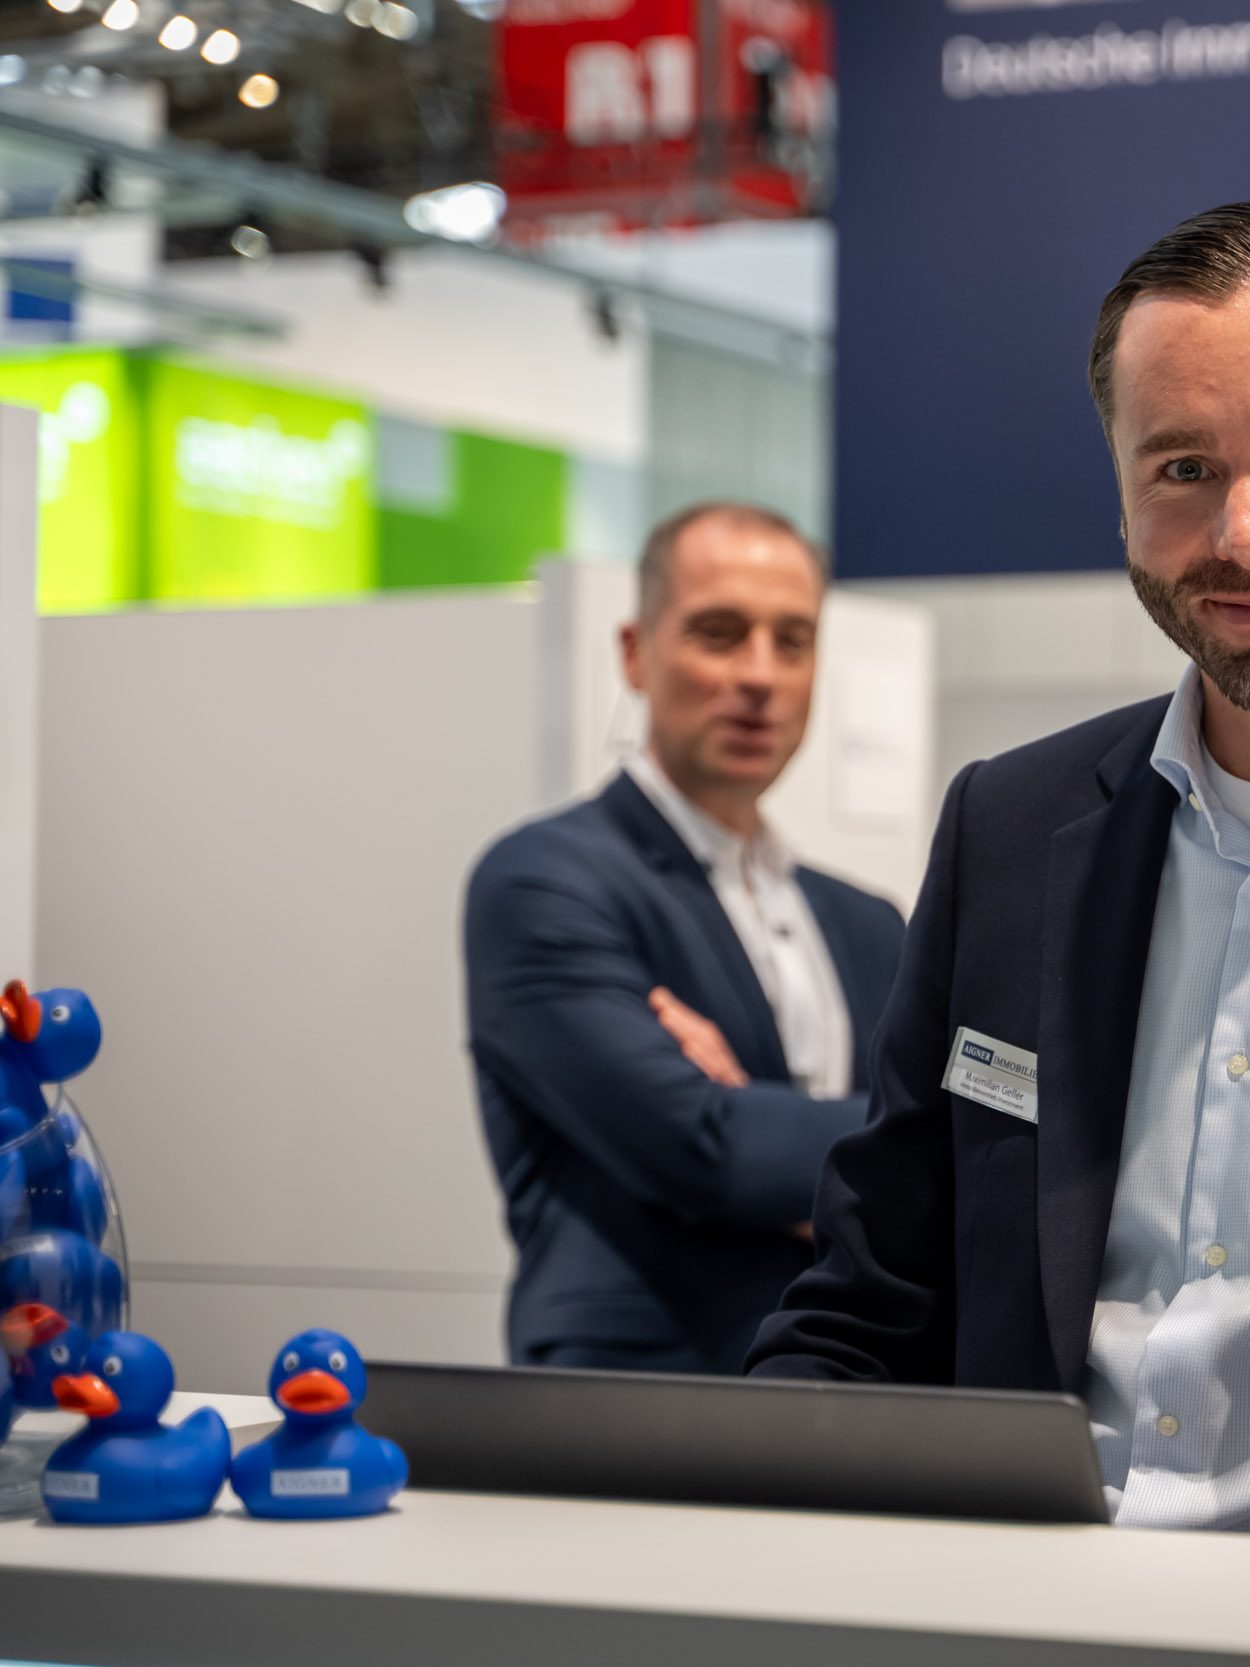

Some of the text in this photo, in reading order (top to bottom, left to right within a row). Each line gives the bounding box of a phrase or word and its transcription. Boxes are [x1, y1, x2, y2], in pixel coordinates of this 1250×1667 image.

[942, 20, 1161, 100] Deutsche
[962, 1043, 992, 1063] AIGNER
[1001, 1085, 1024, 1101] Geller
